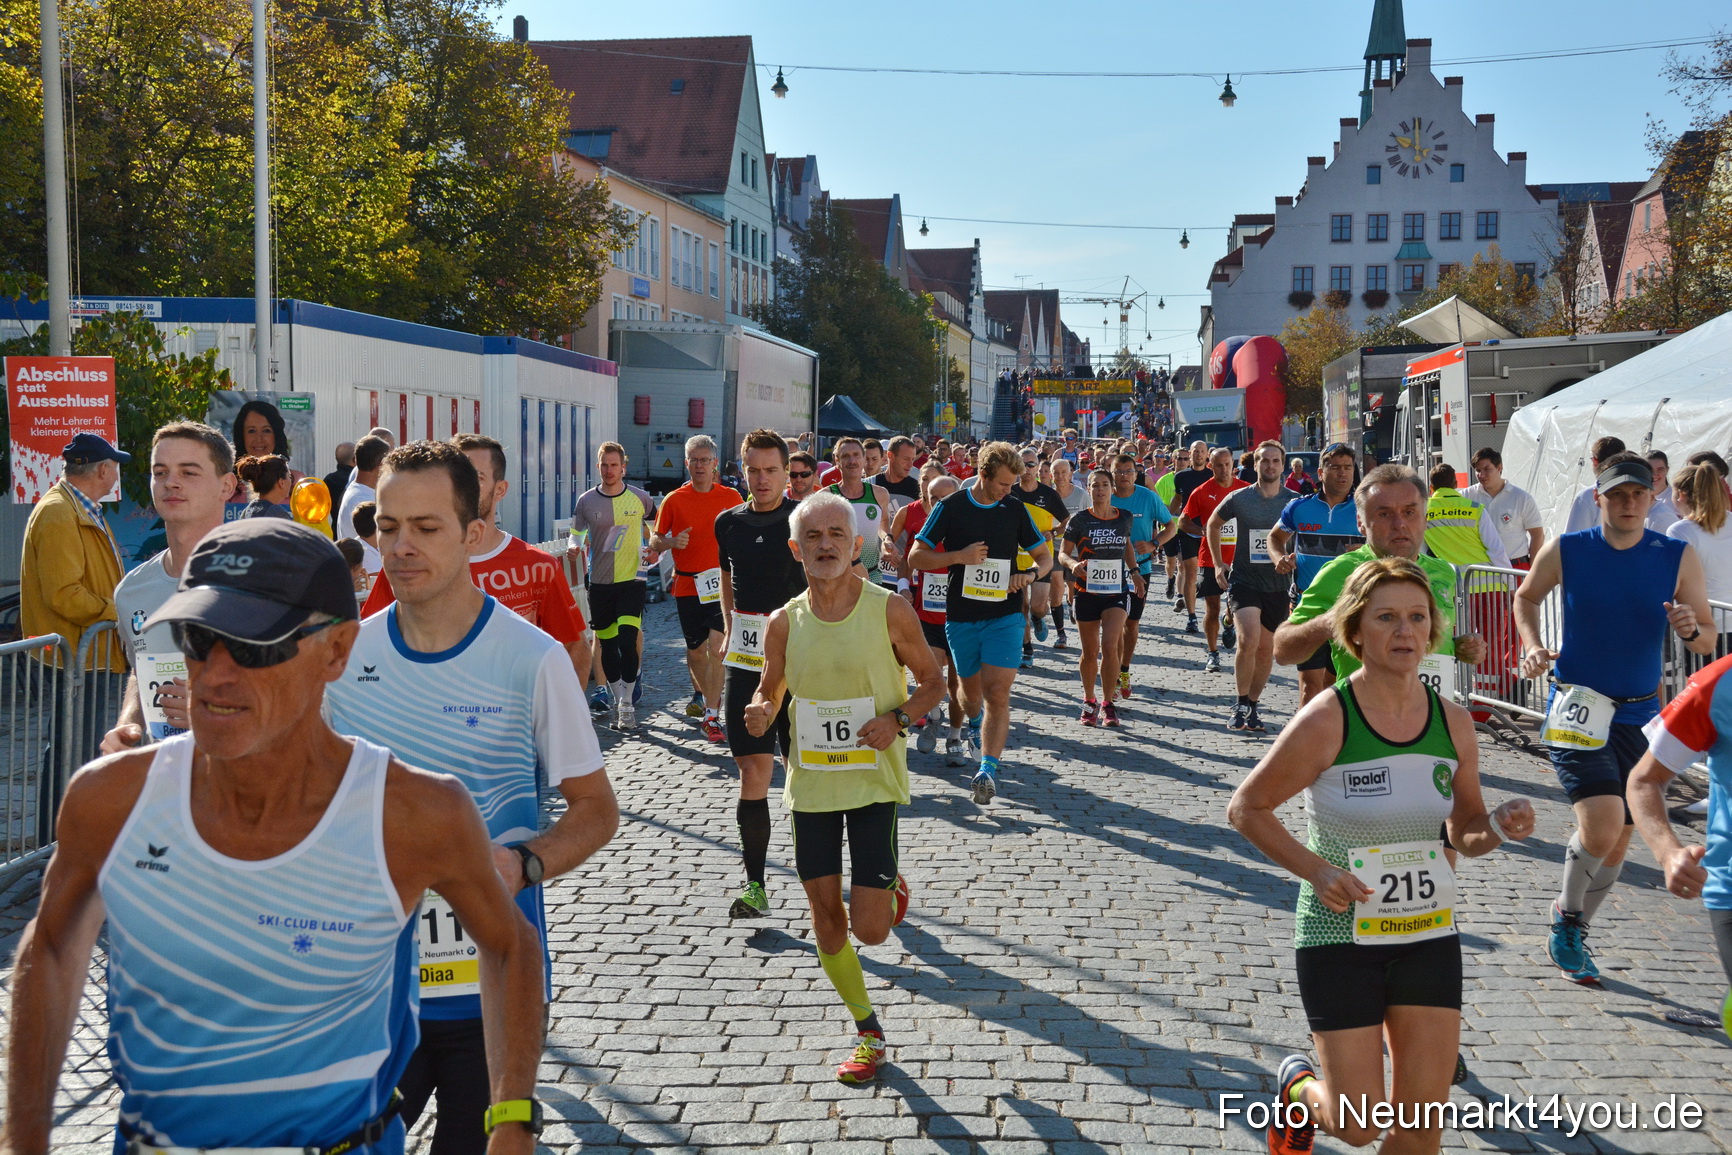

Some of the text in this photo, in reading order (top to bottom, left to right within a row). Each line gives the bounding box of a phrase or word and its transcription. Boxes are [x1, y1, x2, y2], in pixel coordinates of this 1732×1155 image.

[16, 366, 108, 382] Abschluss
[16, 383, 47, 393] statt
[1064, 382, 1101, 392] START
[18, 394, 109, 408] Ausschluss!
[34, 416, 106, 426] Mehr Lehrer für
[30, 427, 69, 437] kleinere
[1088, 528, 1117, 537] HECK
[1297, 523, 1322, 532] GAP
[1091, 536, 1127, 545] DESIGN
[211, 553, 254, 568] TAO
[477, 562, 555, 594] raum
[975, 568, 1000, 584] 310
[1092, 568, 1117, 580] 2018
[975, 589, 995, 597] Florian
[741, 618, 762, 628] BOCK
[742, 629, 758, 648] 94
[156, 661, 189, 673] BOC
[735, 655, 763, 667] Christoph
[357, 674, 380, 683] erima
[482, 706, 503, 714] LAUF
[817, 705, 852, 716] BOCK
[1566, 702, 1590, 725] 90
[821, 719, 851, 742] 16
[1555, 731, 1590, 746] Johannes
[827, 753, 848, 763] Willi
[1358, 786, 1387, 794] Halspastille
[1382, 850, 1425, 865] BOCK
[135, 857, 170, 873] erima
[1380, 869, 1435, 904] 215
[1401, 903, 1430, 913] Neumarkt
[321, 920, 355, 934] LAUF
[418, 907, 463, 945] 11
[1380, 917, 1433, 932] Christine
[424, 948, 464, 959] Neumarkt
[419, 967, 454, 983] Diaa
